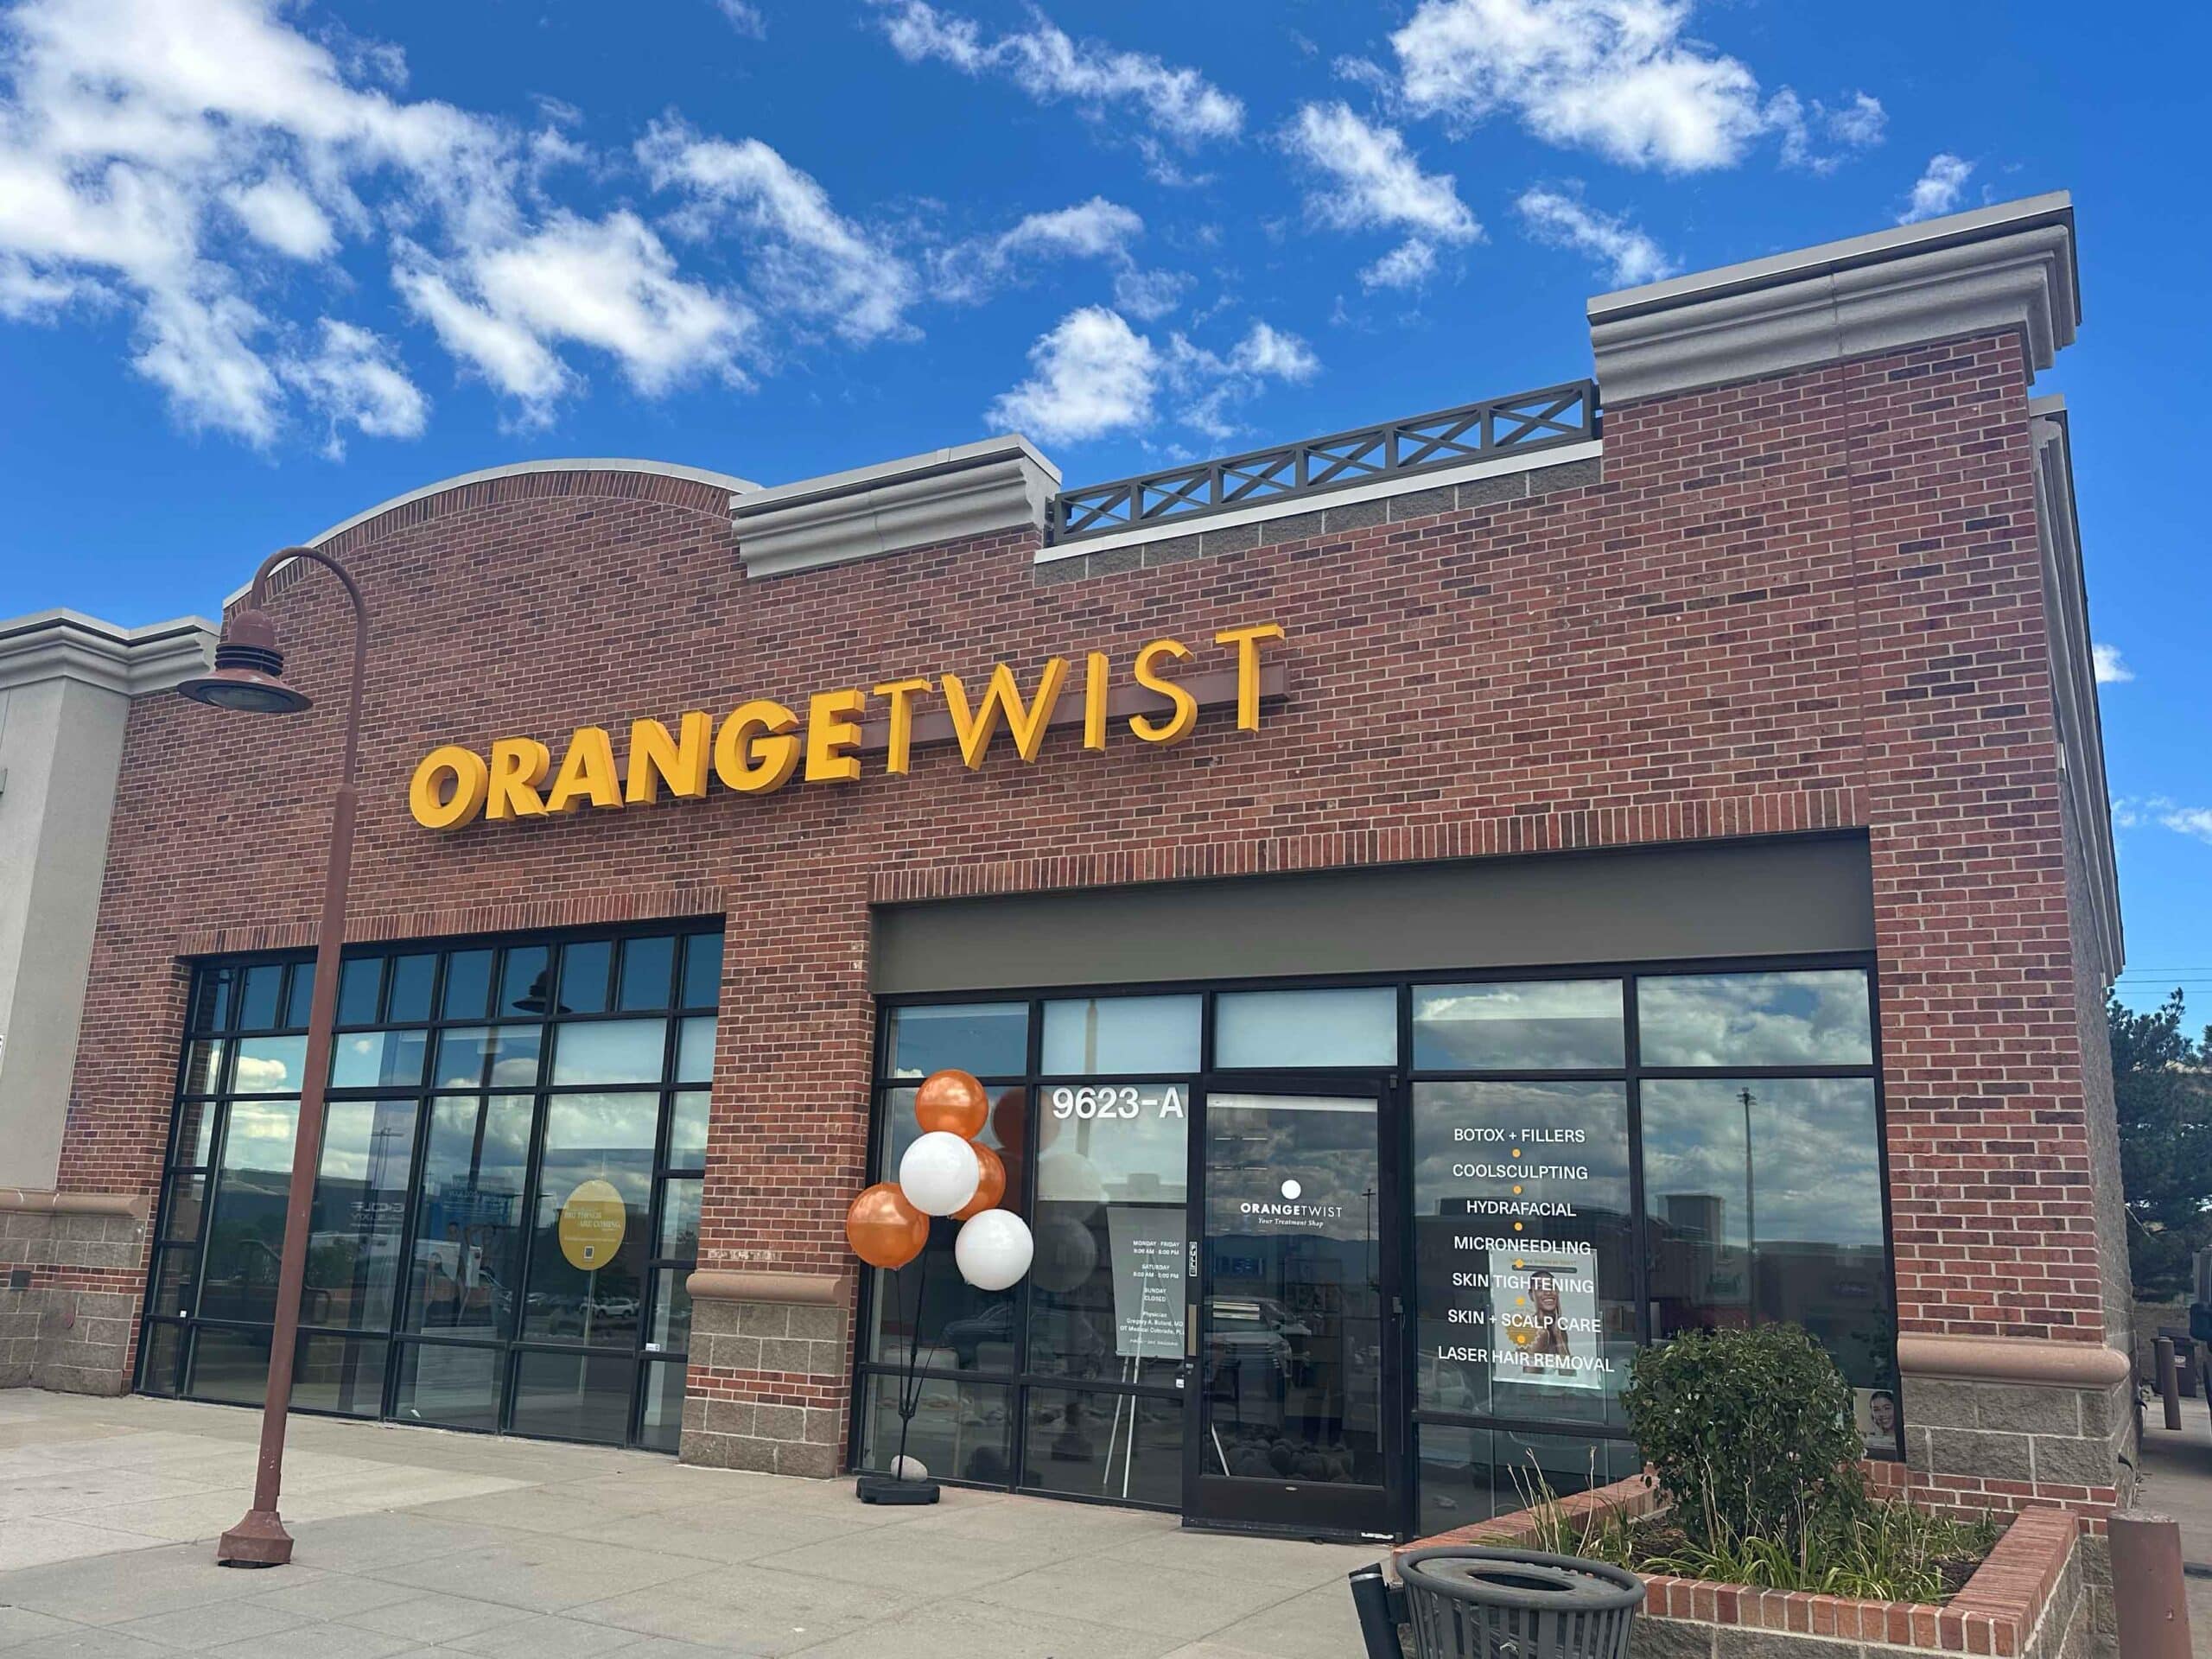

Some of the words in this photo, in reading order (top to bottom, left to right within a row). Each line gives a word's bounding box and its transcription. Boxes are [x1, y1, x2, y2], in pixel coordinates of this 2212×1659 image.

[409, 623, 1286, 830] ORANGETWIST
[1052, 1087, 1185, 1119] 9623-A
[1454, 1128, 1504, 1141] BOTOX
[1509, 1131, 1517, 1140] +
[1522, 1129, 1586, 1143] FILLERS
[1452, 1164, 1588, 1180] COOLSCULPTING
[1240, 1203, 1342, 1217] ORANGETWIST
[1466, 1200, 1577, 1217] HYDRAFACIAL
[1454, 1236, 1591, 1255] MICRONEEDLING
[1452, 1273, 1489, 1287] SKIN
[1493, 1274, 1594, 1294] TIGHTENING
[1447, 1310, 1484, 1325] SKIN
[1489, 1315, 1497, 1324] +
[1502, 1313, 1554, 1330] SCALP
[1557, 1318, 1602, 1333] CARE
[1438, 1346, 1488, 1363] LASER
[1492, 1351, 1529, 1366] HAIR
[1535, 1353, 1615, 1372] REMOVAL
